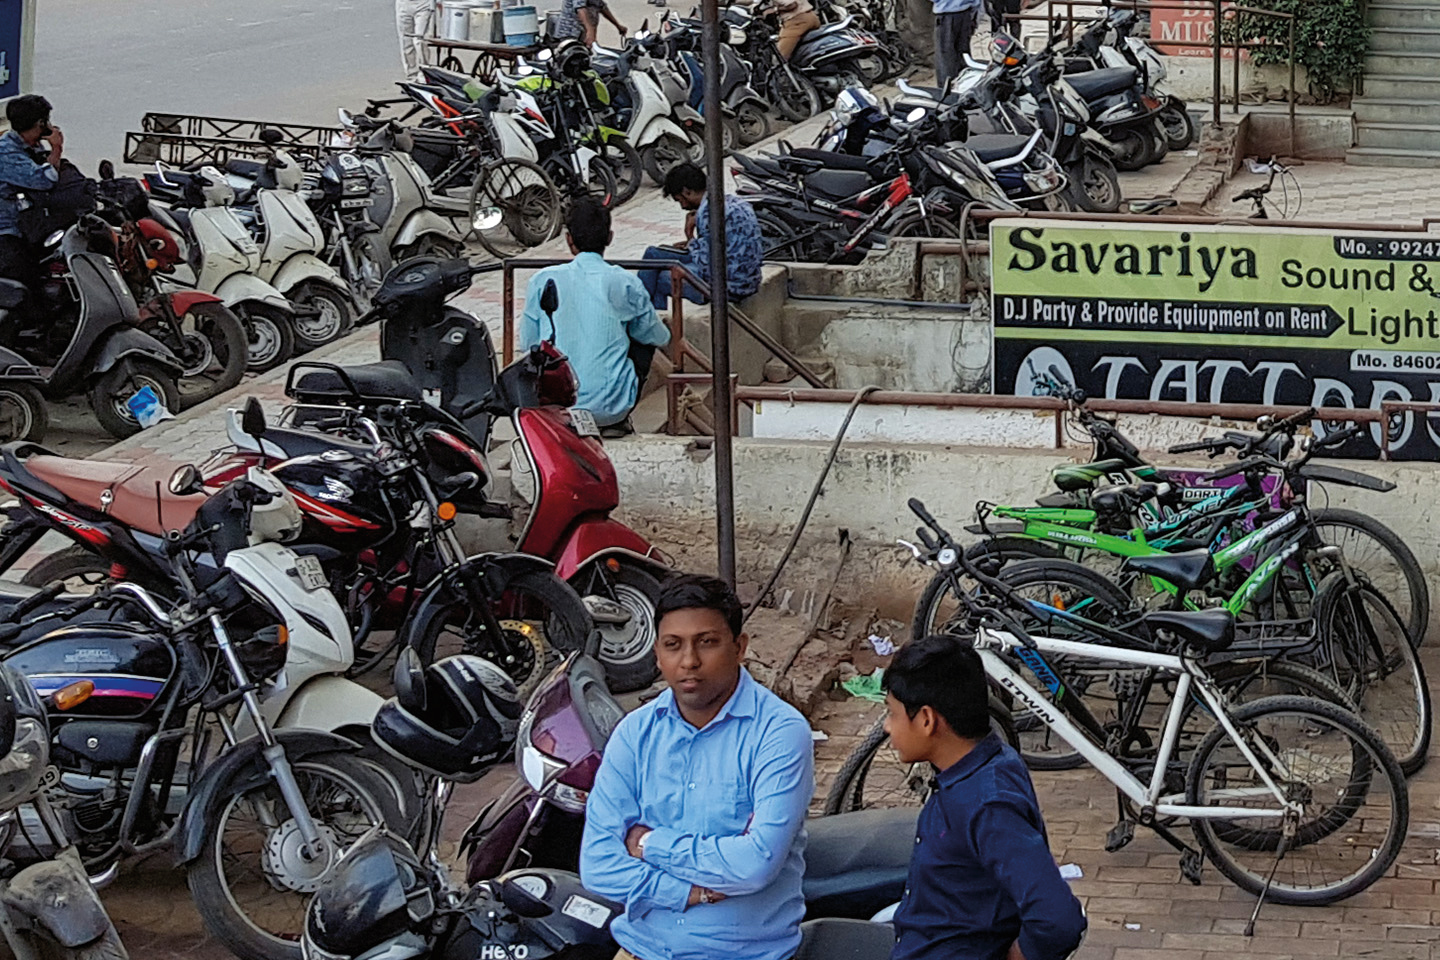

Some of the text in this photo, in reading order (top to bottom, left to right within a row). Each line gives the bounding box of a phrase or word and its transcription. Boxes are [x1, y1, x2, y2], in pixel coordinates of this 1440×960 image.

[1008, 227, 1258, 292] Savariya
[1340, 239, 1371, 255] Mo.
[1281, 259, 1434, 294] Sound &
[1003, 297, 1328, 332] D.J Party & Provide Equiupment on Rent
[1356, 353, 1387, 368] Mo.
[1183, 488, 1221, 499] DART
[1001, 678, 1055, 723] BTWIN
